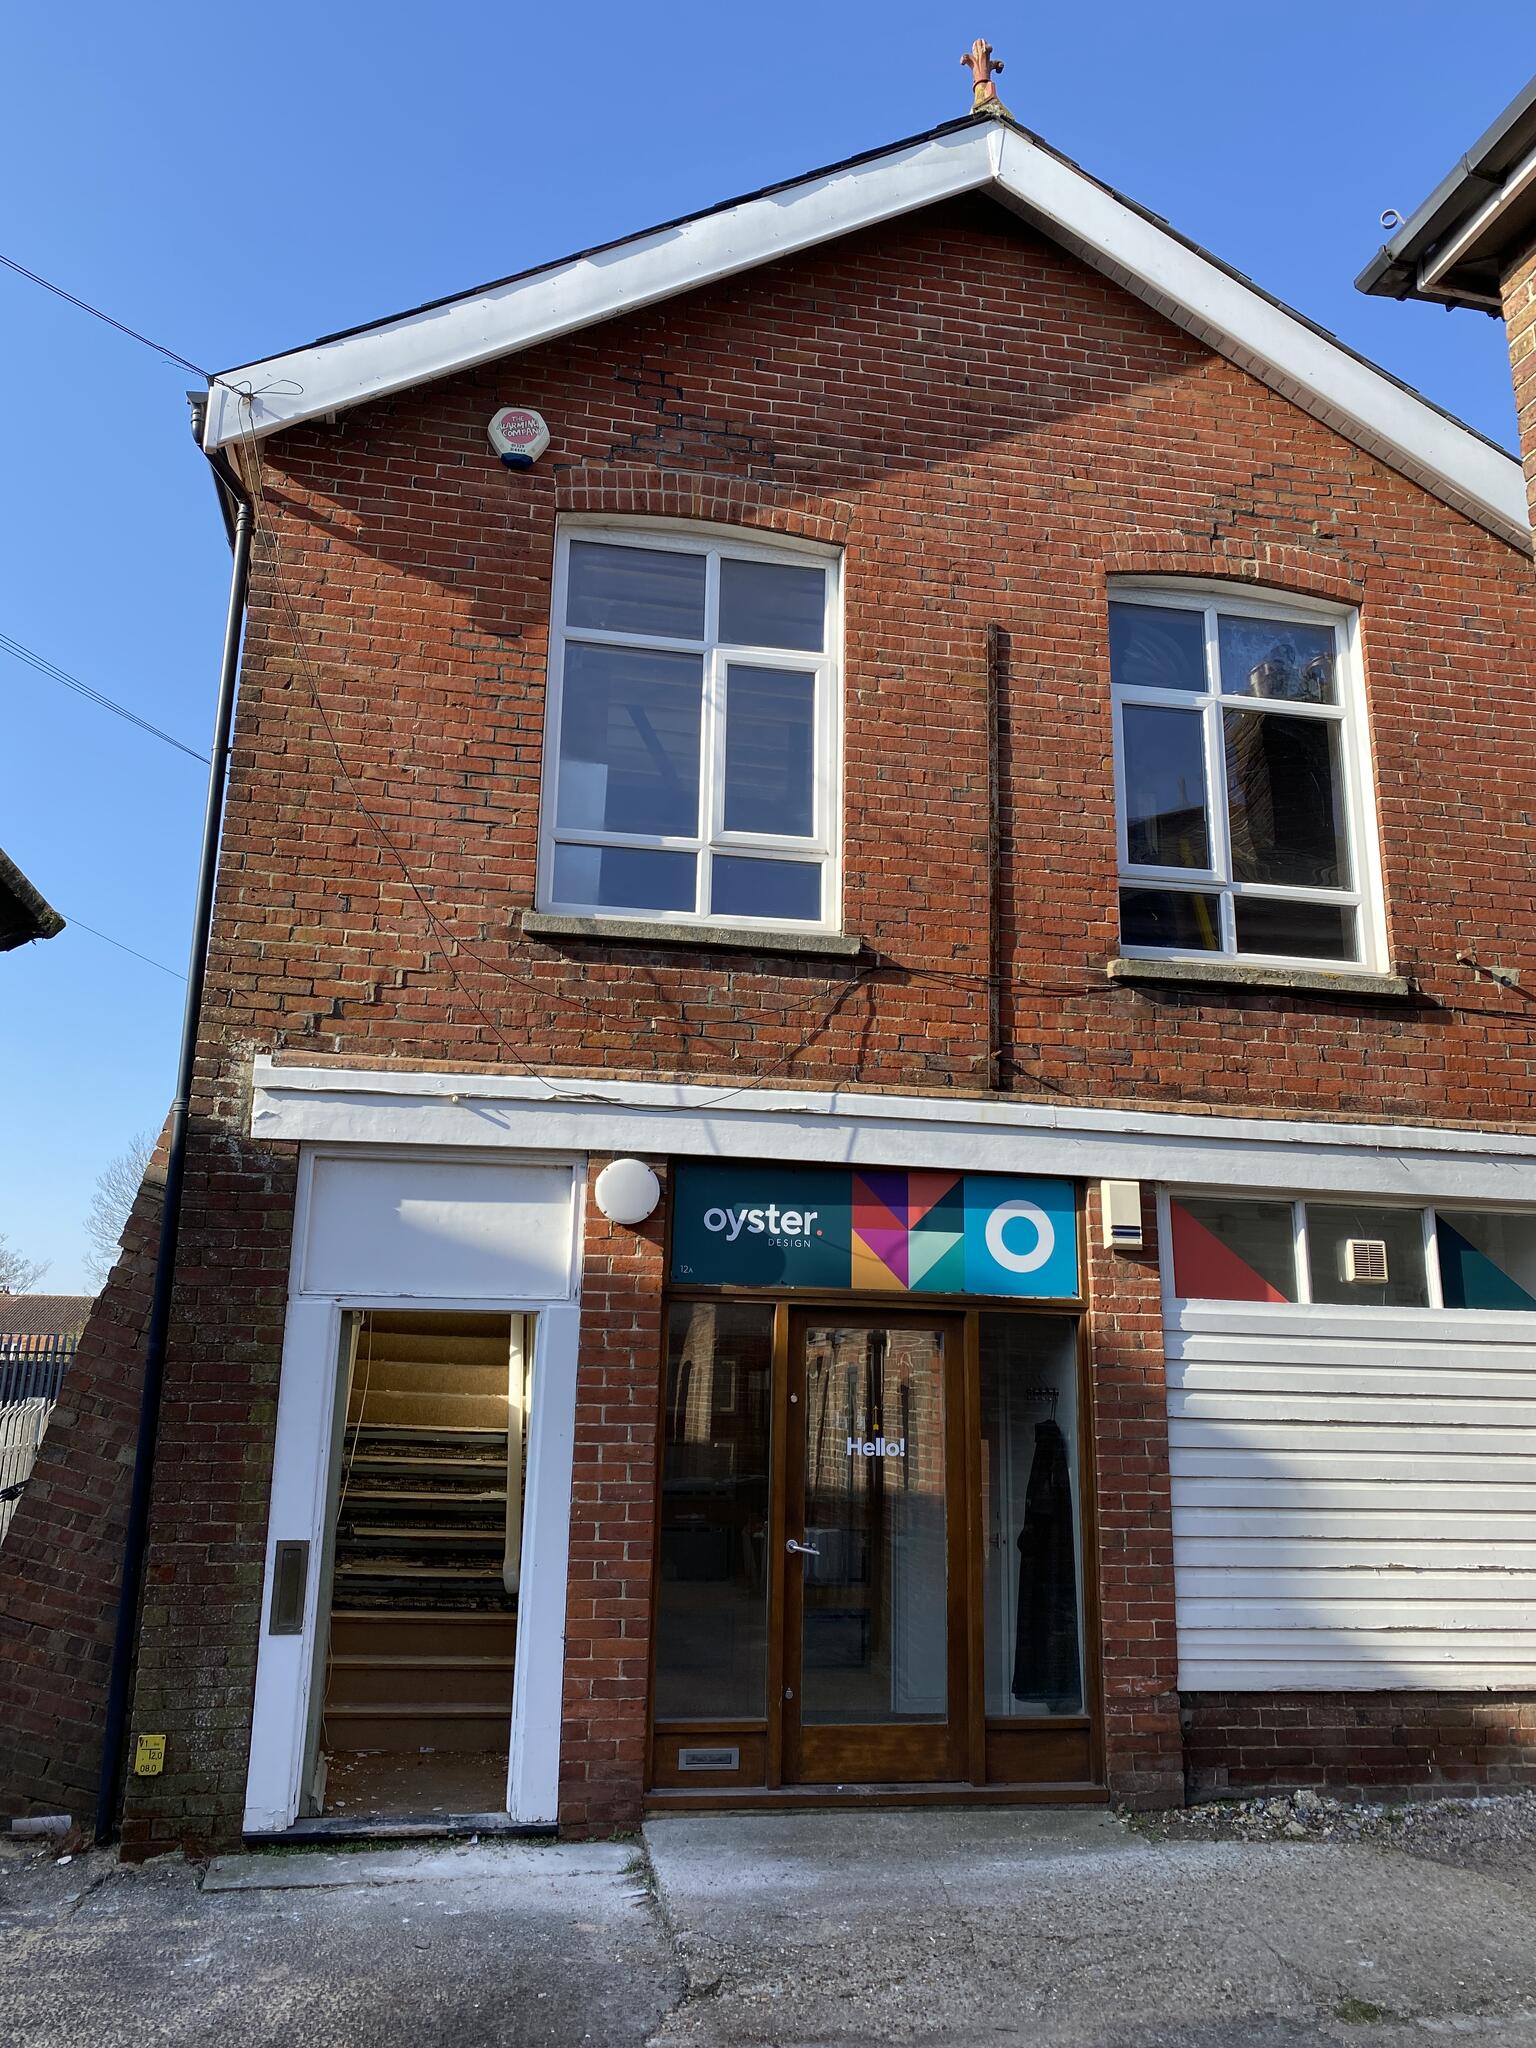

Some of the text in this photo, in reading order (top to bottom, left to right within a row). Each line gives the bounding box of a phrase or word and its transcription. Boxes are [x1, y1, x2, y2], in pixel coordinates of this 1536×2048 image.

[502, 426, 545, 437] COMPANY
[768, 1239, 811, 1248] DESIGN
[847, 1437, 905, 1457] Hello!
